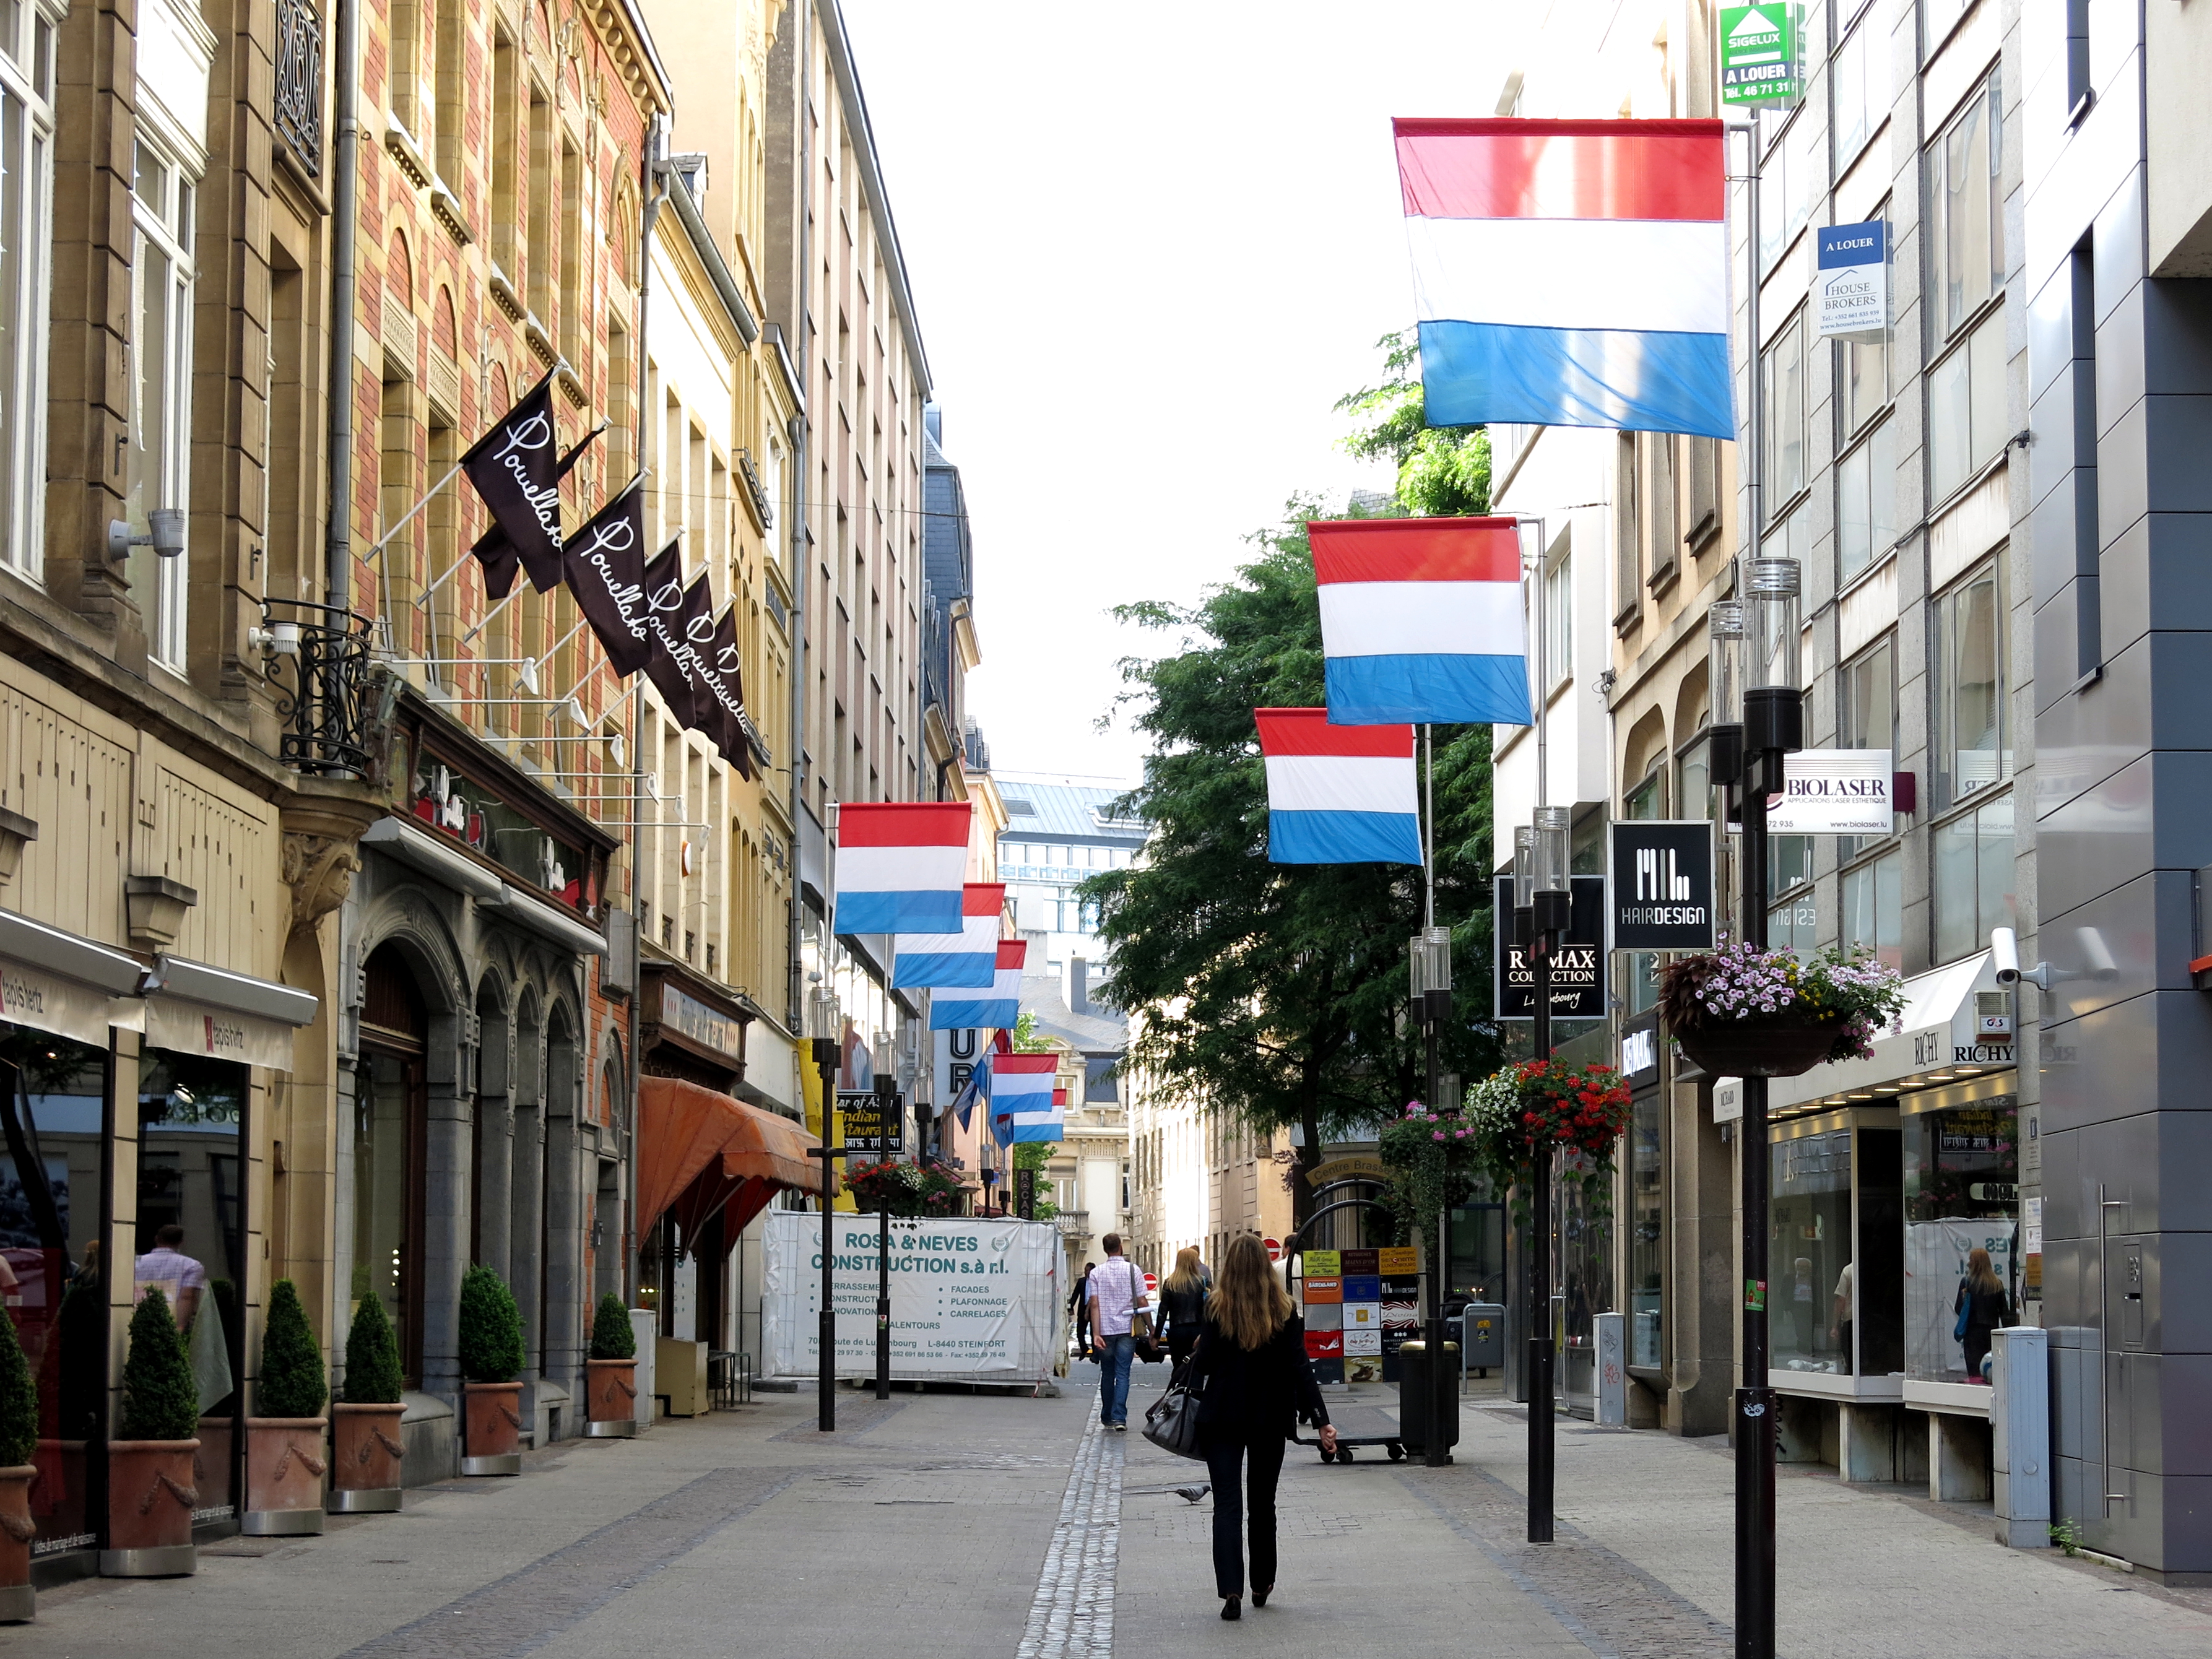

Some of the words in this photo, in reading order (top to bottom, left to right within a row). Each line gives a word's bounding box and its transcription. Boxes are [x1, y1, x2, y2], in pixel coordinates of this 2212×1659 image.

[1728, 32, 1780, 48] SIGELUX
[1726, 69, 1737, 84] A
[1740, 64, 1786, 82] LOUER
[1724, 87, 1741, 99] Tél.
[1743, 85, 1758, 97] 46
[1758, 83, 1773, 95] 71
[1776, 80, 1789, 92] 31
[1826, 243, 1834, 252] A
[1837, 237, 1873, 251] LOUER
[1831, 282, 1870, 296] HOUSE
[1825, 295, 1876, 310] BROKERS
[1819, 318, 1882, 329] www.housebrokers.lu
[1787, 779, 1886, 795] BIOLASER
[1830, 820, 1887, 828] www.biolaser.lu
[1509, 971, 1595, 982] COLCTION
[1987, 1018, 2003, 1028] G4S
[1914, 1031, 1939, 1066] RICHY
[1954, 1044, 2015, 1062] RICHY
[844, 1109, 881, 1122] ndian
[1314, 1163, 1350, 1180] Centre
[901, 1235, 914, 1250] &
[919, 1236, 978, 1251] NEVES
[960, 1258, 984, 1273] s.à
[989, 1258, 1009, 1274] r.l.
